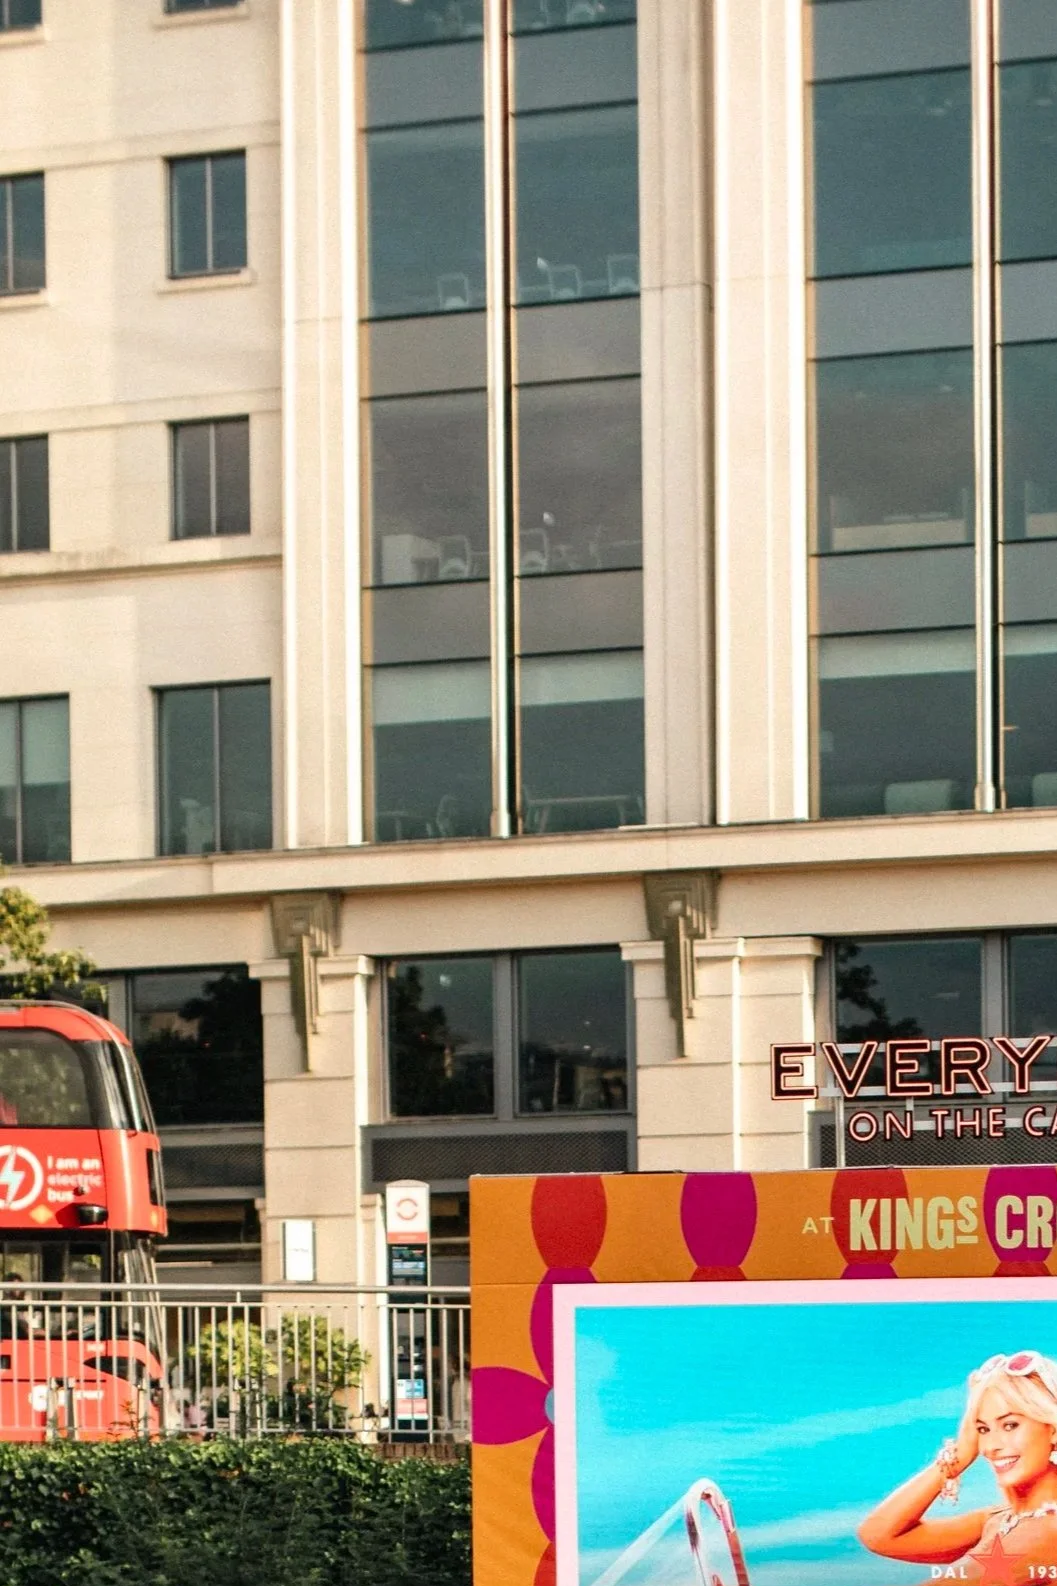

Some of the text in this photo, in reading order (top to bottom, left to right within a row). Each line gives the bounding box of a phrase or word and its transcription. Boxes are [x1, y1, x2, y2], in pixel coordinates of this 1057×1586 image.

[847, 1109, 913, 1143] ON
[931, 1106, 1006, 1139] THE
[801, 1216, 835, 1235] AT
[848, 1196, 979, 1252] KINGS
[931, 1565, 969, 1580] DAL
